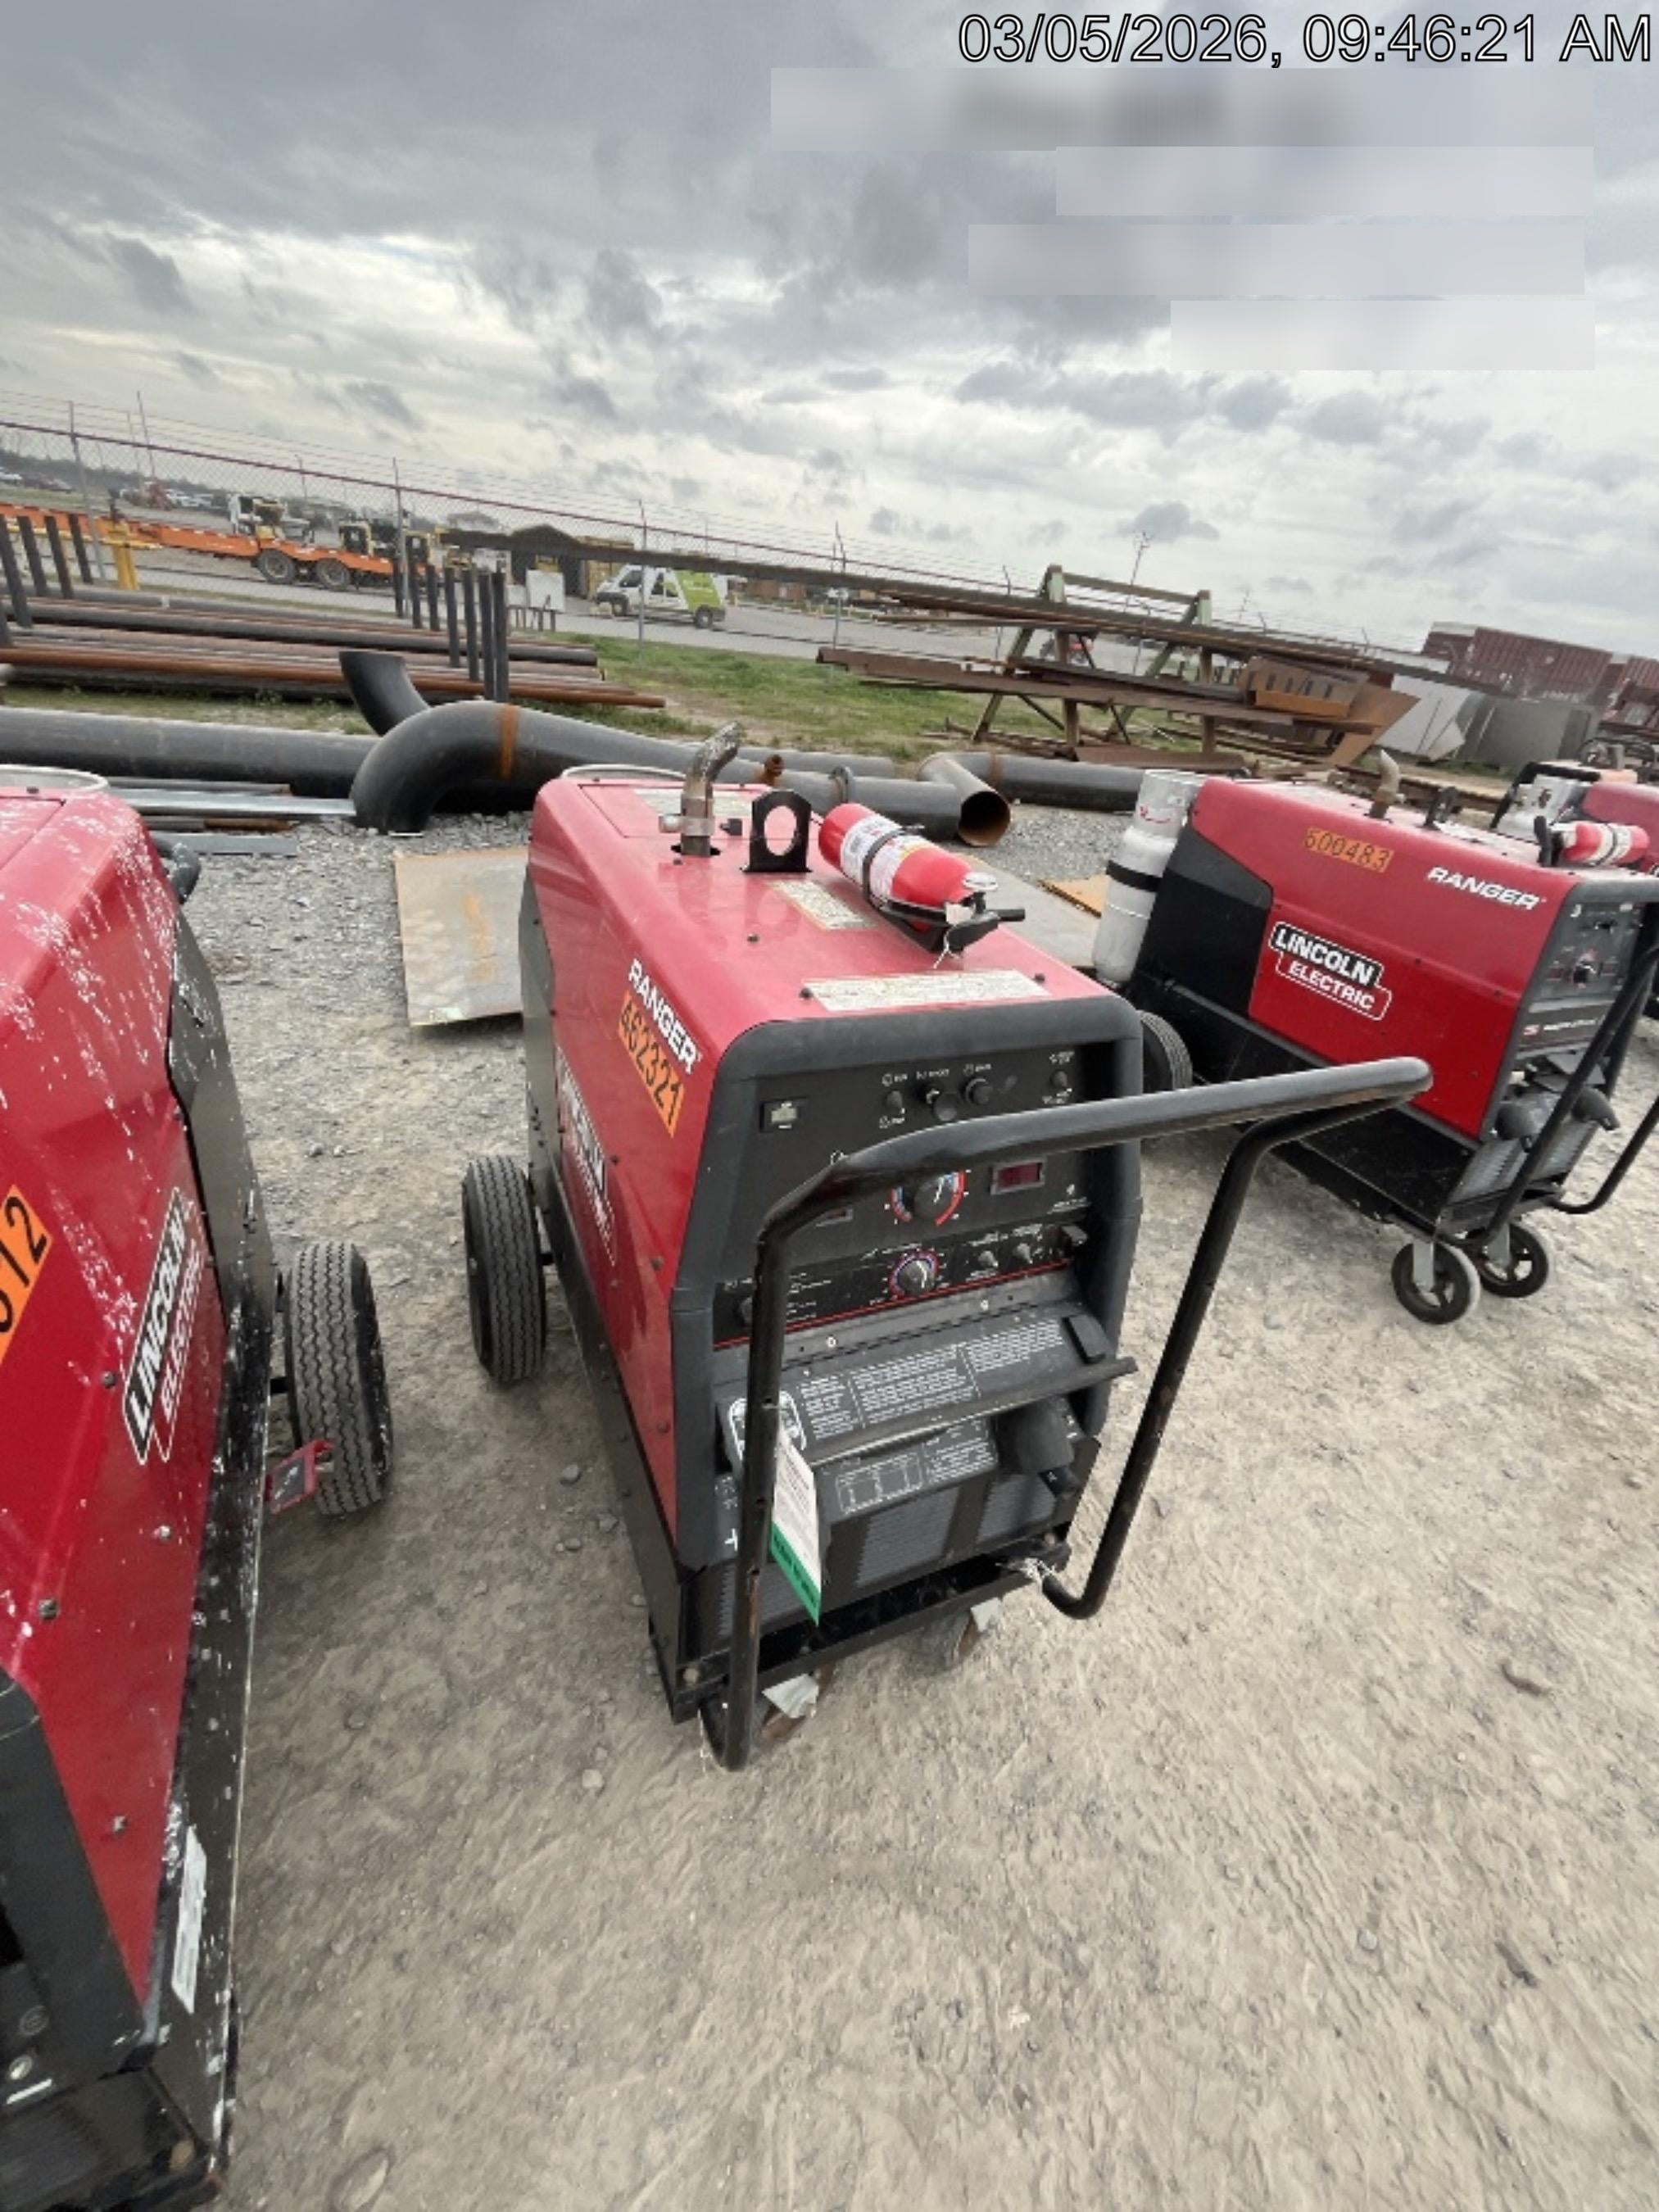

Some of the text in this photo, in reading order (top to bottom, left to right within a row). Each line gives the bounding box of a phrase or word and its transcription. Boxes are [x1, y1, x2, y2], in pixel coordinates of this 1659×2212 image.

[1426, 865, 1541, 911] RANGER
[1275, 927, 1375, 986] LINCOLN
[1288, 959, 1376, 1010] ELECTRIC
[628, 957, 698, 1076] RANGER
[129, 1204, 187, 1440] LINCOLN
